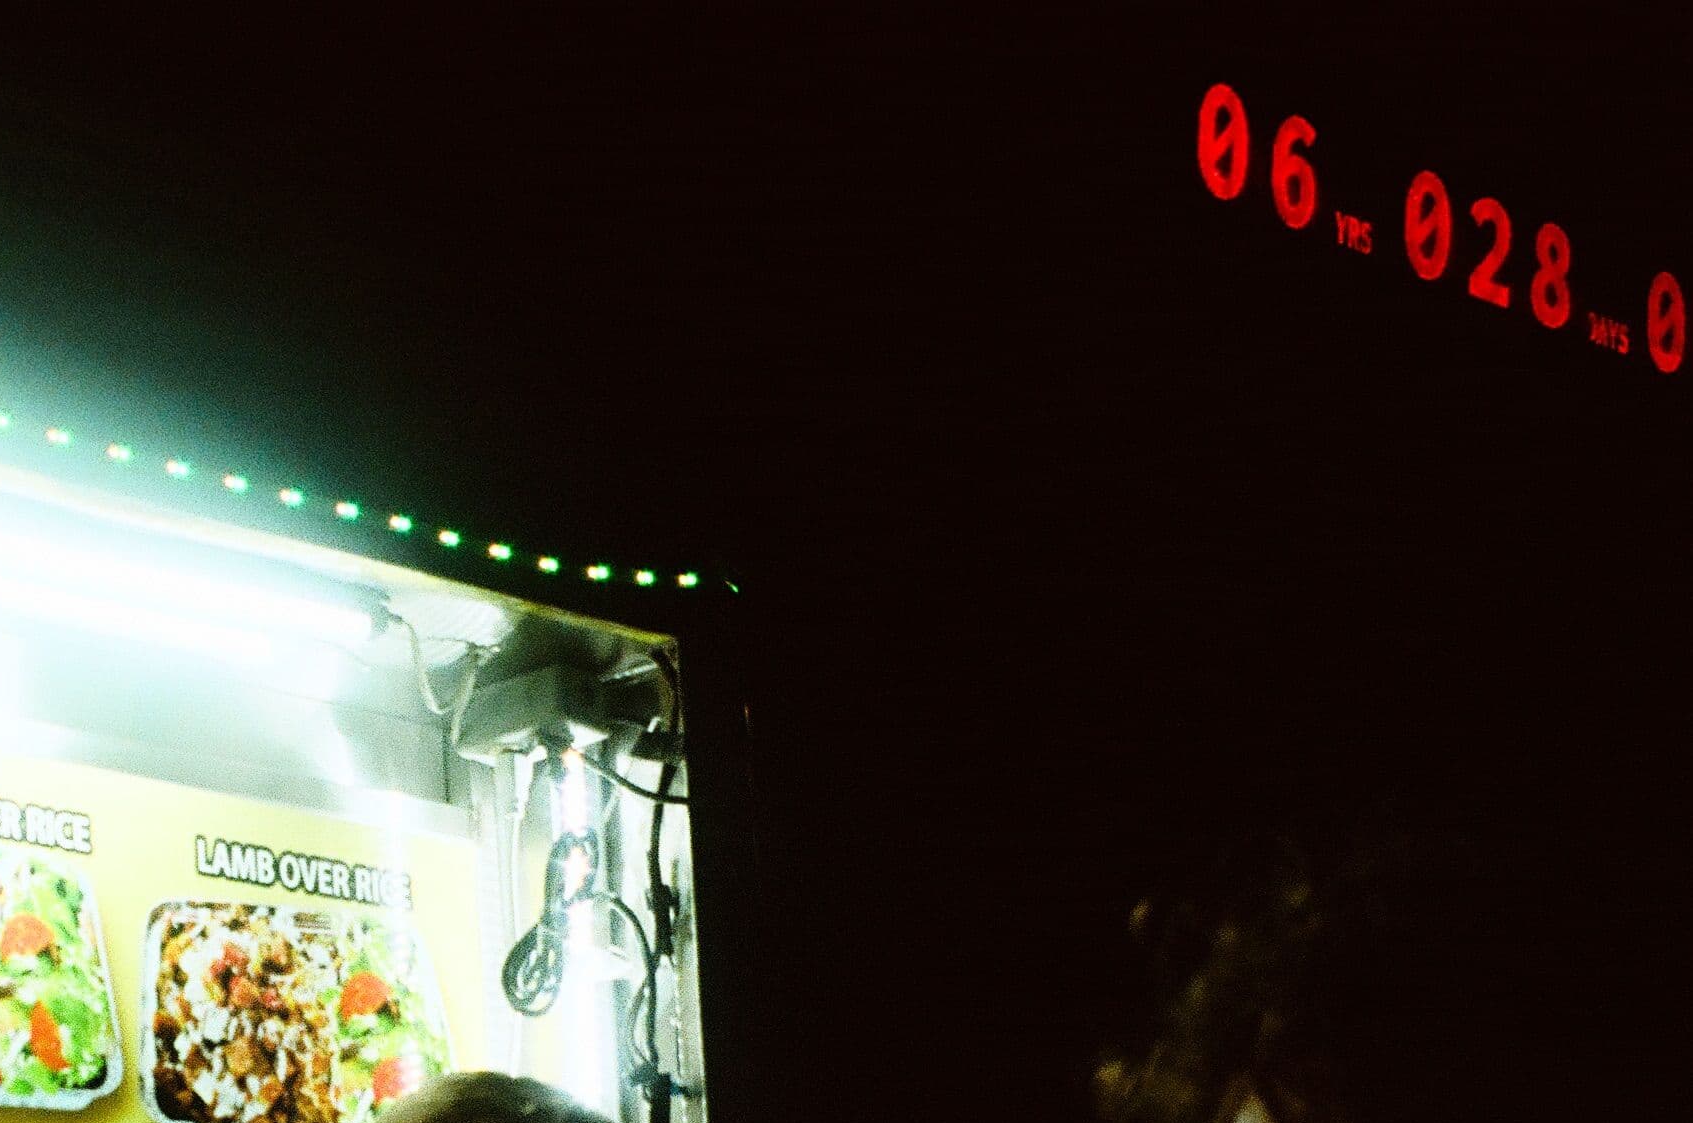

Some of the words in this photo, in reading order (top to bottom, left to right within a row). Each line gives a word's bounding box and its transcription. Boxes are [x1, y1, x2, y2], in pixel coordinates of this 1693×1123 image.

[1197, 83, 1317, 230] 06
[1335, 210, 1374, 255] YRS
[1405, 169, 1571, 329] 028
[22, 803, 93, 855] RICE
[196, 835, 276, 886] LAMB
[278, 851, 352, 899] OVER
[354, 864, 414, 910] RICE
